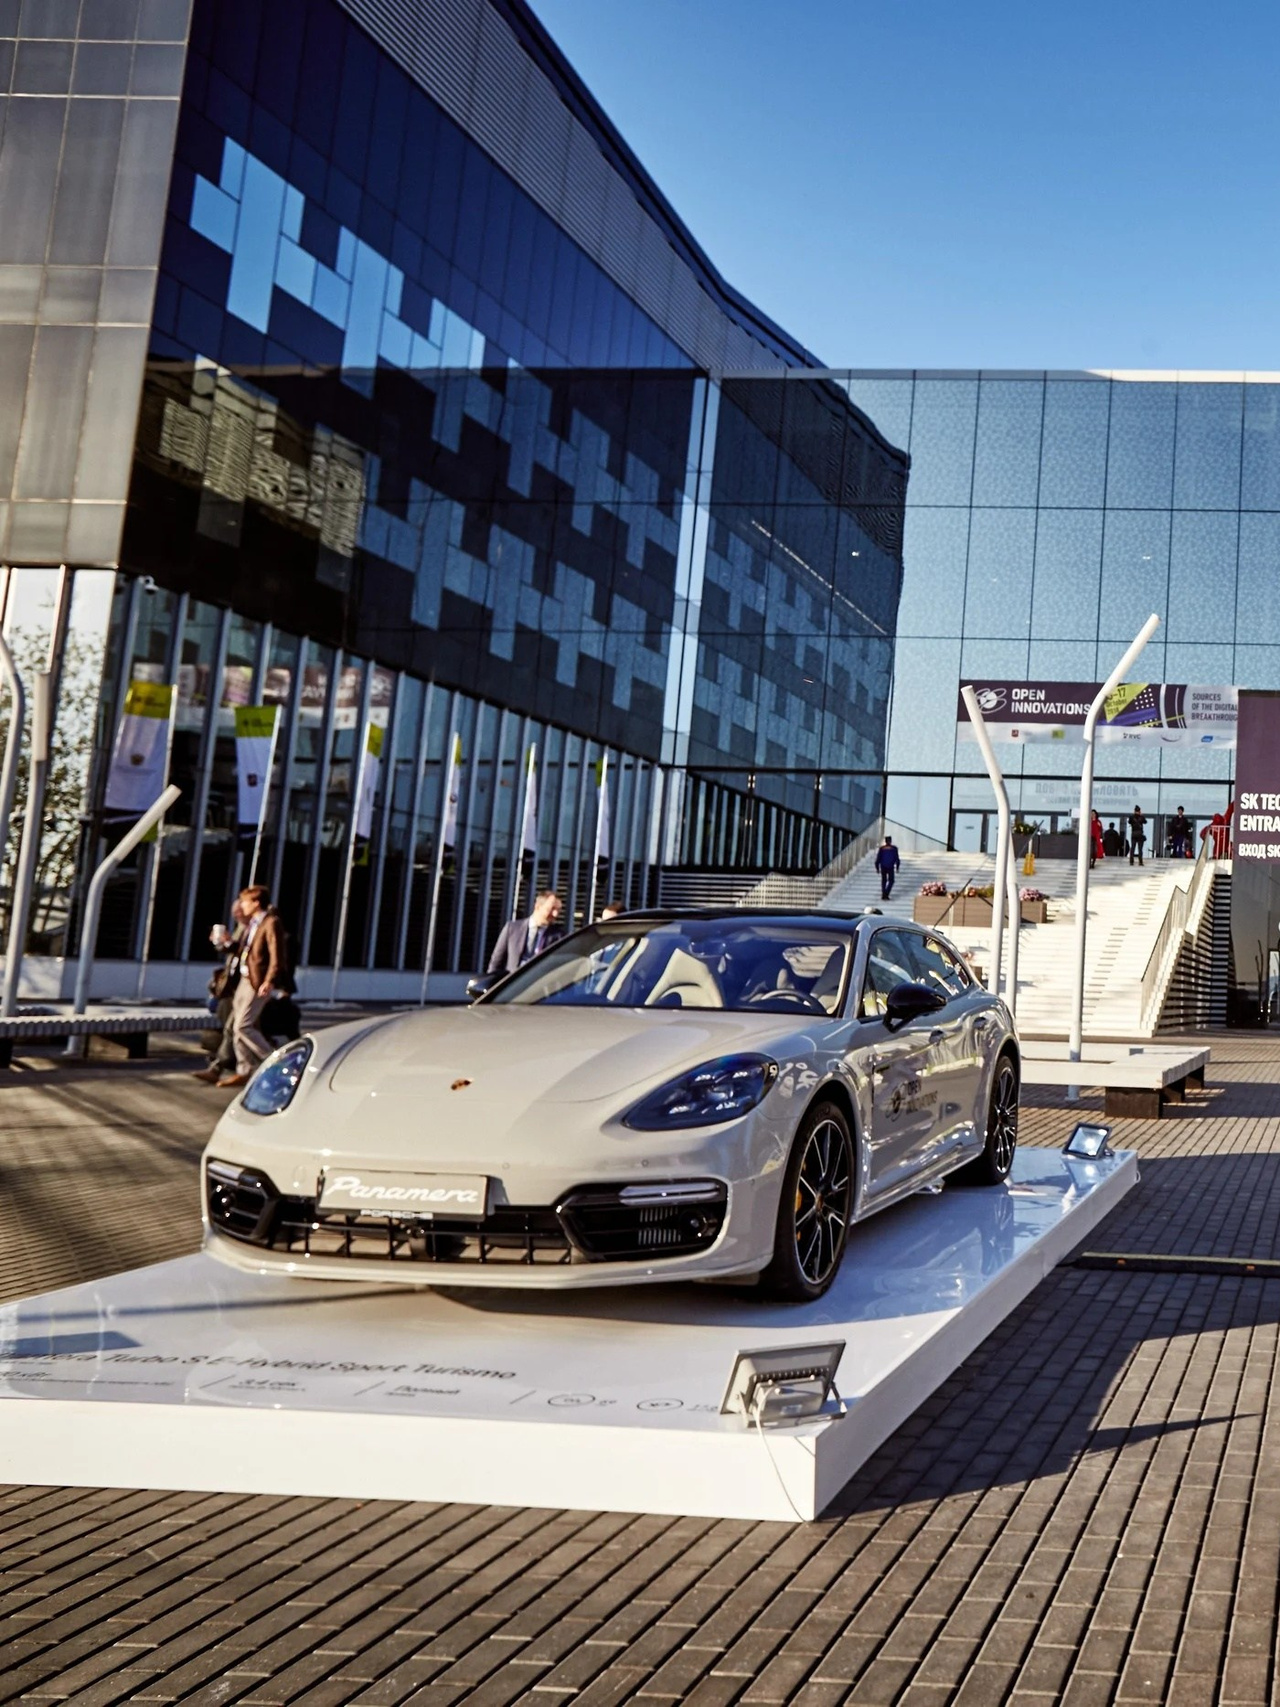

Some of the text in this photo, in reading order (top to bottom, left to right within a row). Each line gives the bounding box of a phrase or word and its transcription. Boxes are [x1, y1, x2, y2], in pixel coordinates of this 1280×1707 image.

[1011, 688, 1046, 700] OPEN
[1192, 692, 1222, 701] SOURCES
[1011, 702, 1092, 715] INNOVATIONS
[1191, 702, 1238, 711] OF THE DIGITAL
[1191, 712, 1238, 721] BREAKTHROUG
[1240, 793, 1259, 810] SK
[1238, 843, 1266, 859] ВХОД
[1267, 844, 1280, 858] SK
[325, 1176, 479, 1203] Panamera
[330, 1361, 407, 1373] Sport
[413, 1363, 516, 1379] Turismo
